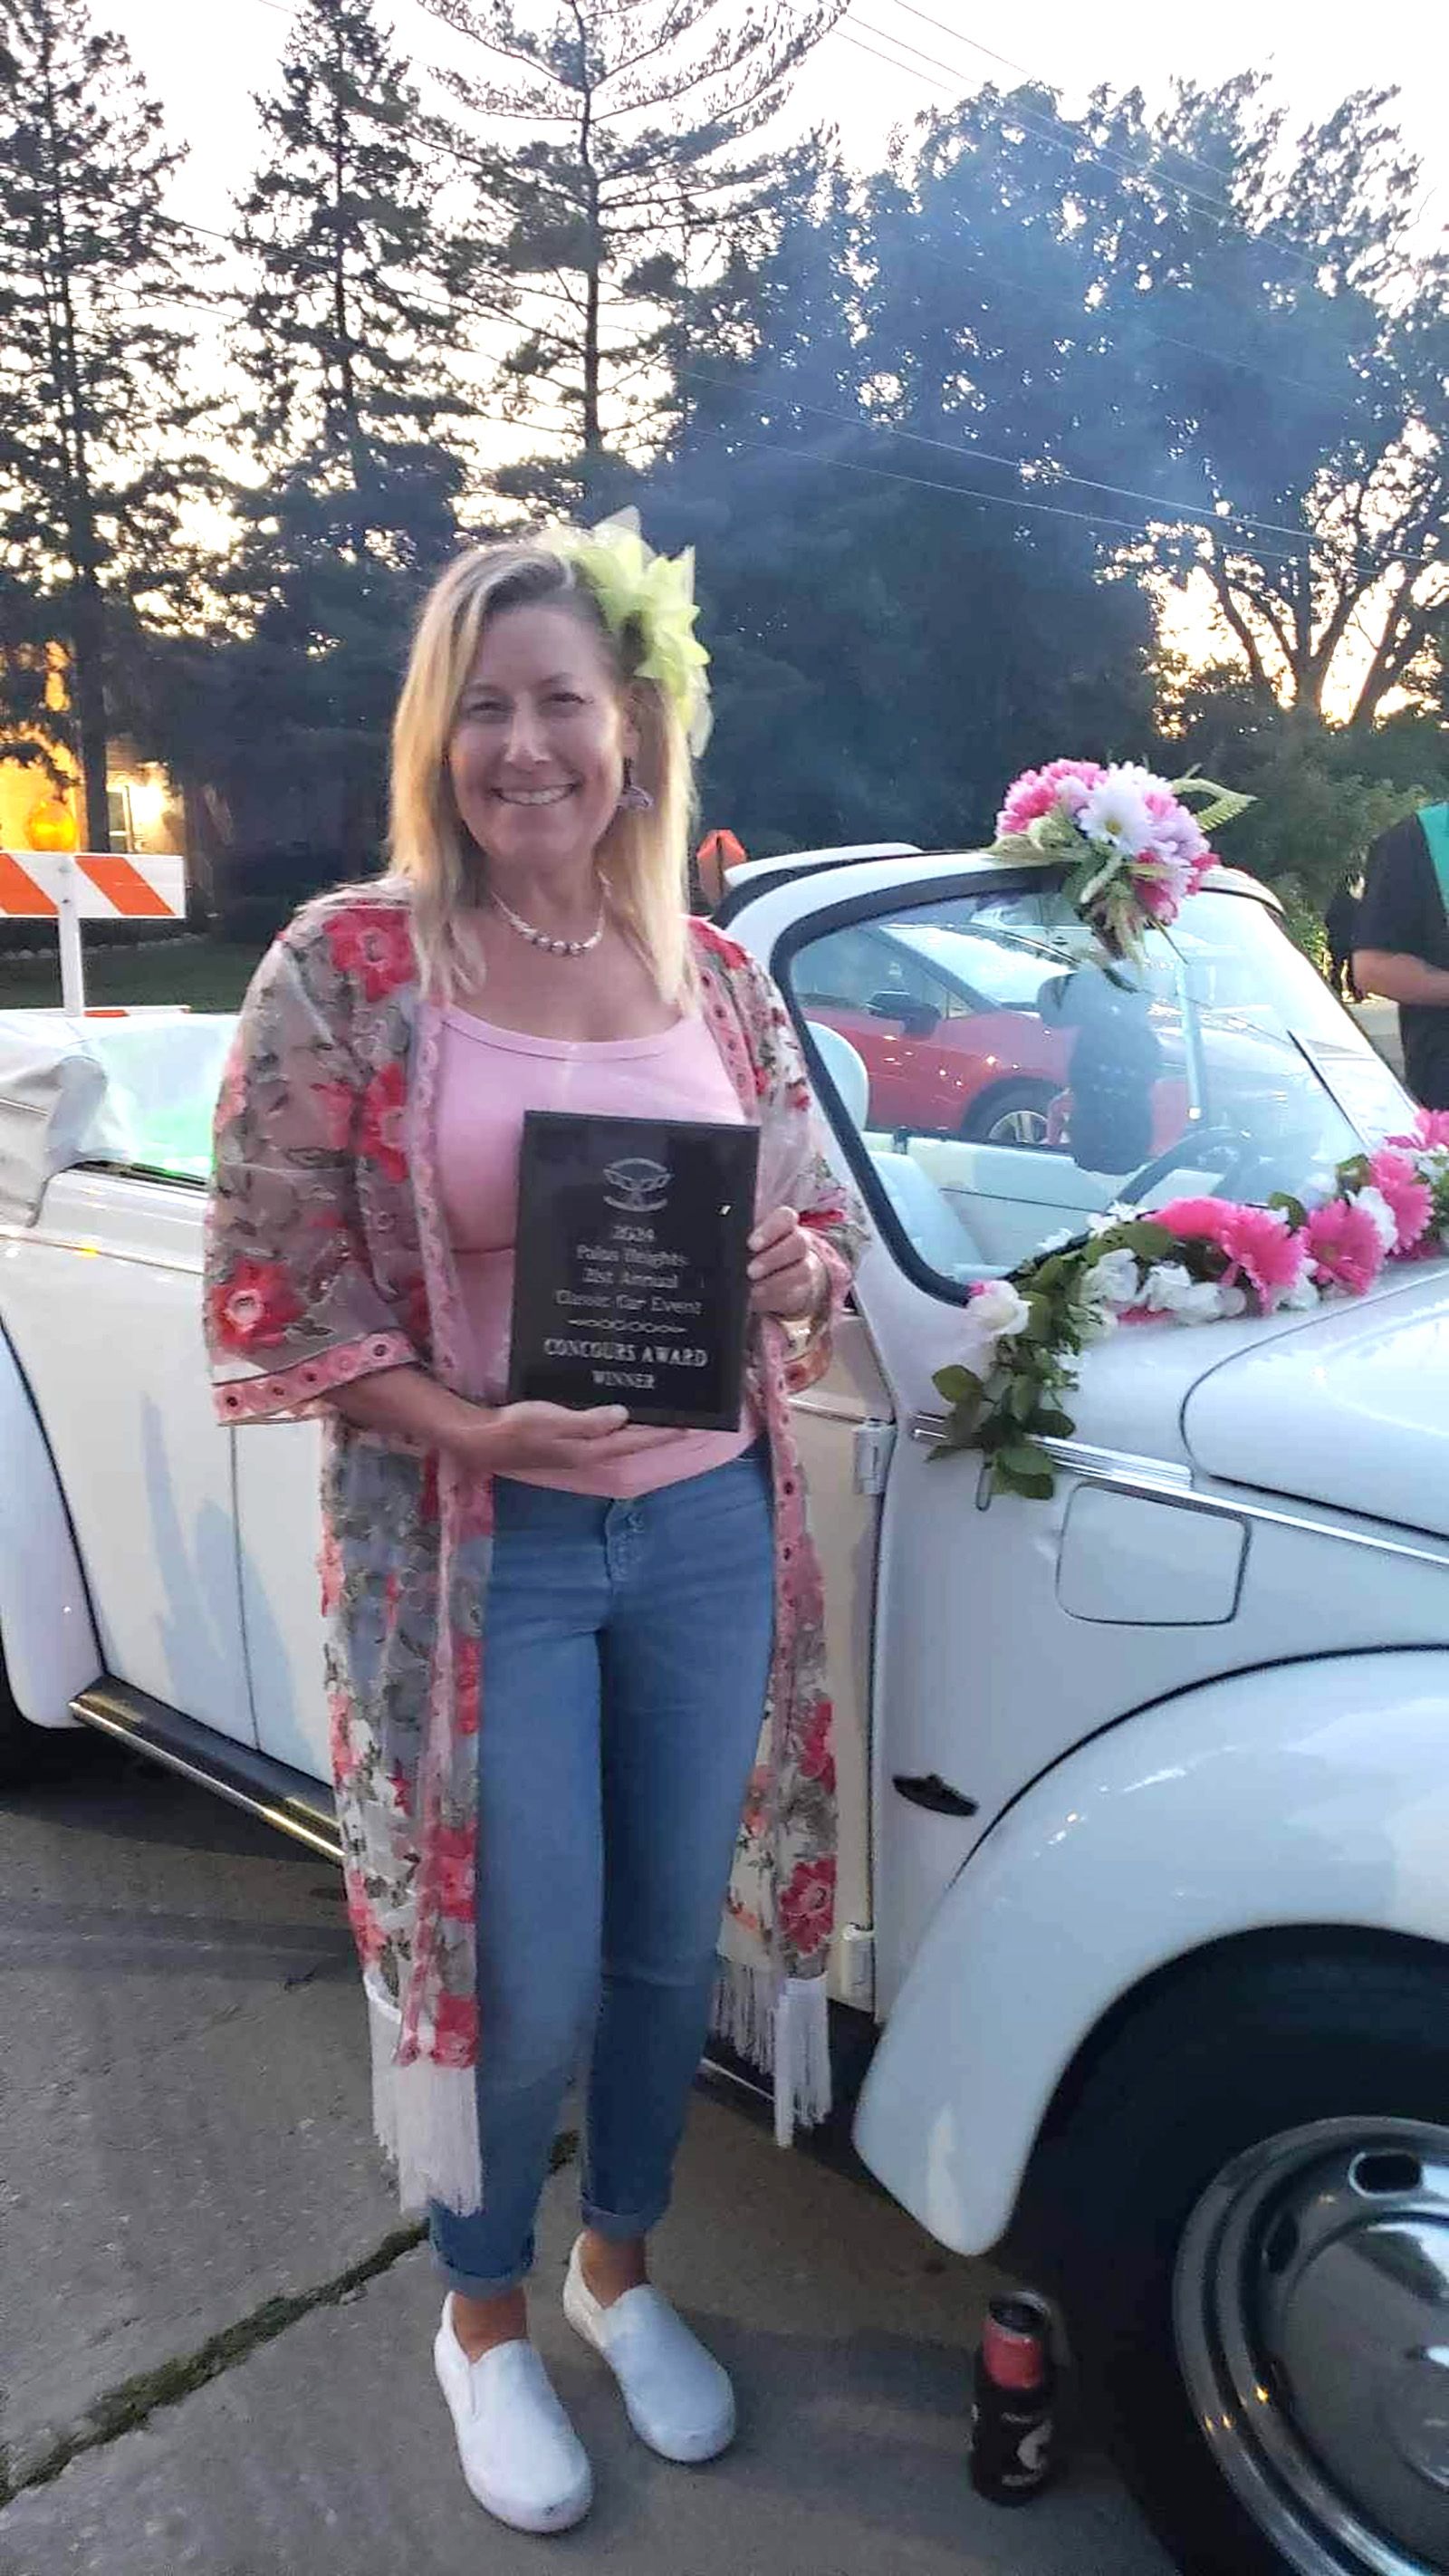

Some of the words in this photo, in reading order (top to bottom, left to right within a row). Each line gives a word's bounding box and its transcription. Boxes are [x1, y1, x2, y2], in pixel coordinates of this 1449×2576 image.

[619, 1271, 678, 1288] Annual
[555, 1289, 610, 1308] Classic
[616, 1294, 648, 1310] Car
[651, 1297, 702, 1314] Event
[543, 1338, 637, 1361] CONCOURS
[641, 1346, 708, 1367] AWARD
[591, 1370, 656, 1389] WINNER
